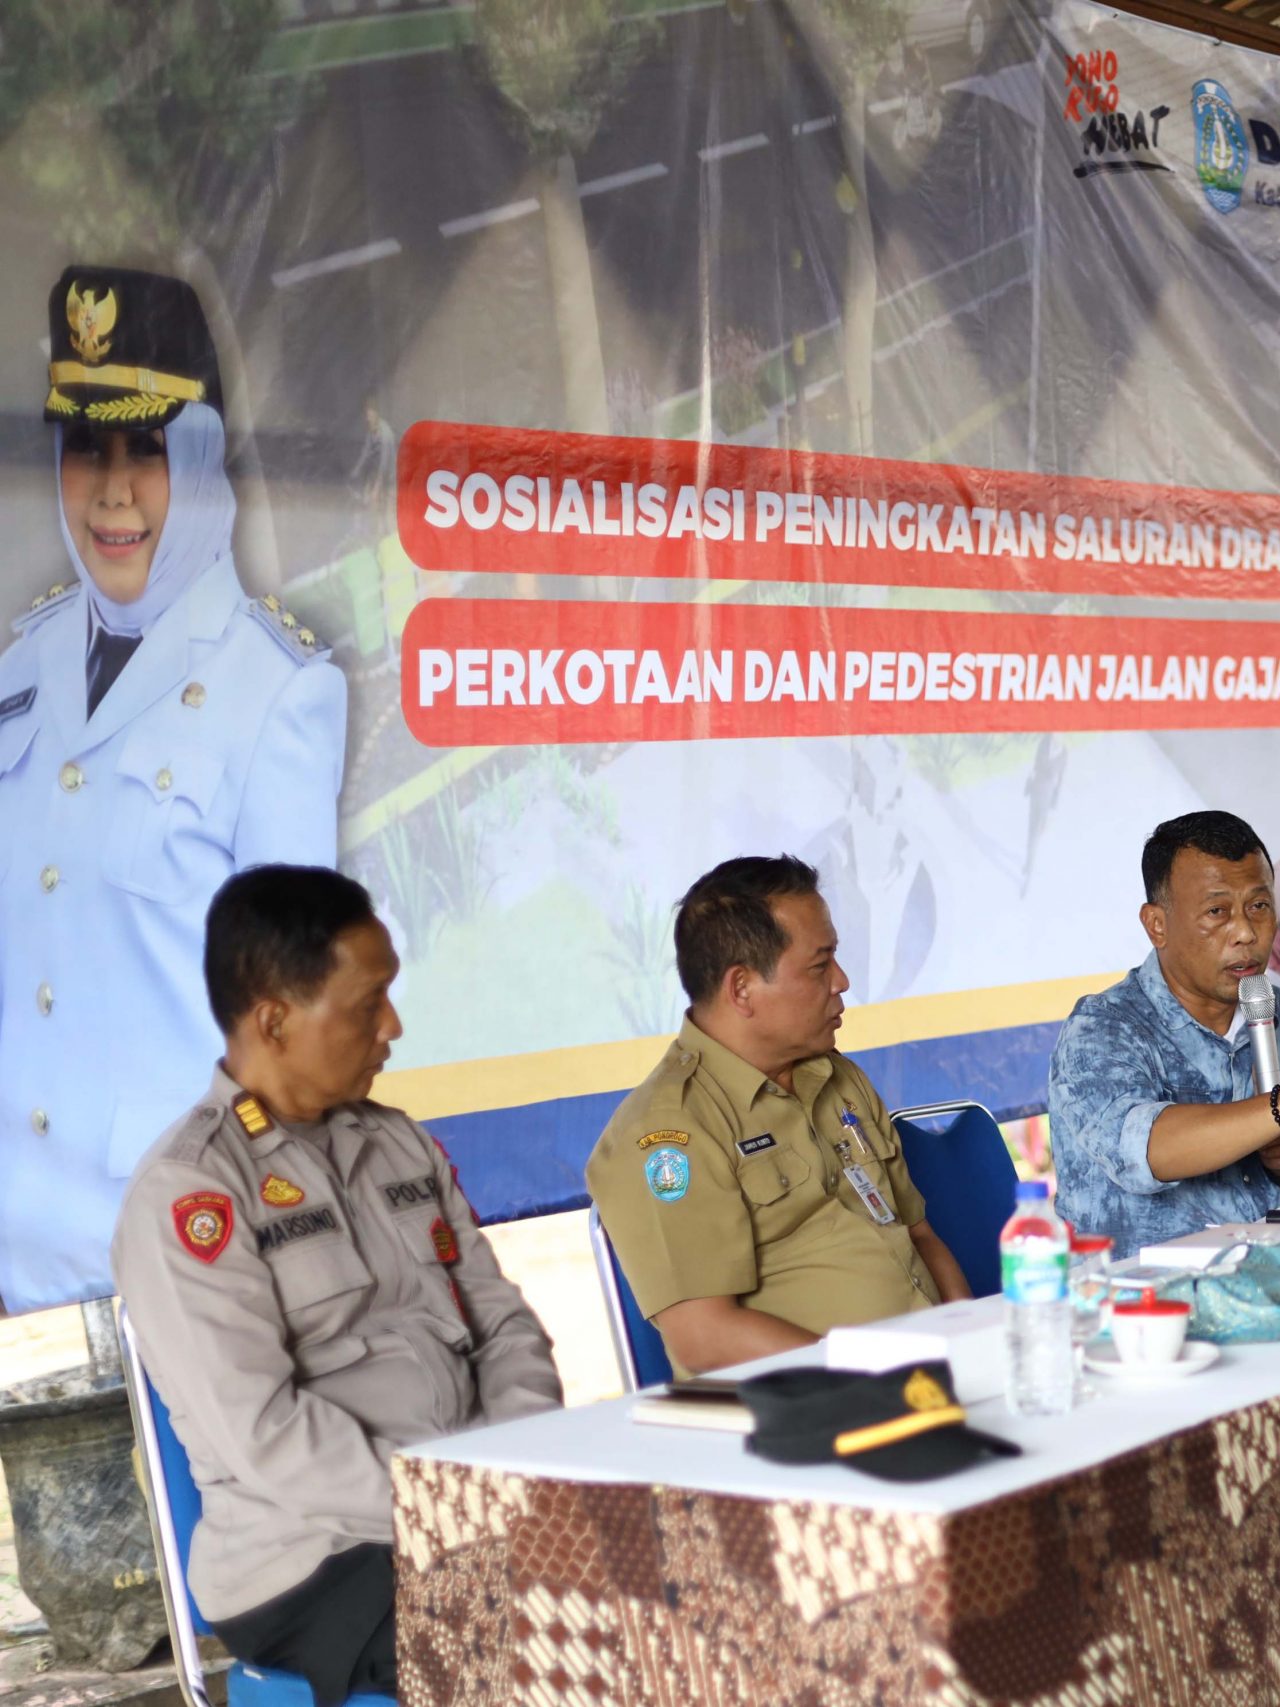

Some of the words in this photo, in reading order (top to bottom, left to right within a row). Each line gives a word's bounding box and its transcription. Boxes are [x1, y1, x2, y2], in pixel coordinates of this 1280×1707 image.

[424, 469, 746, 542] SOSIALISASI
[755, 491, 1046, 560] PENINGKATAN
[1053, 512, 1215, 569] SALURAN
[418, 648, 734, 707] PERKOTAAN
[743, 650, 837, 703] DAN
[844, 651, 1092, 702] PEDESTRIAN
[1096, 655, 1209, 701] JALAN
[256, 1208, 337, 1249] MARSONO
